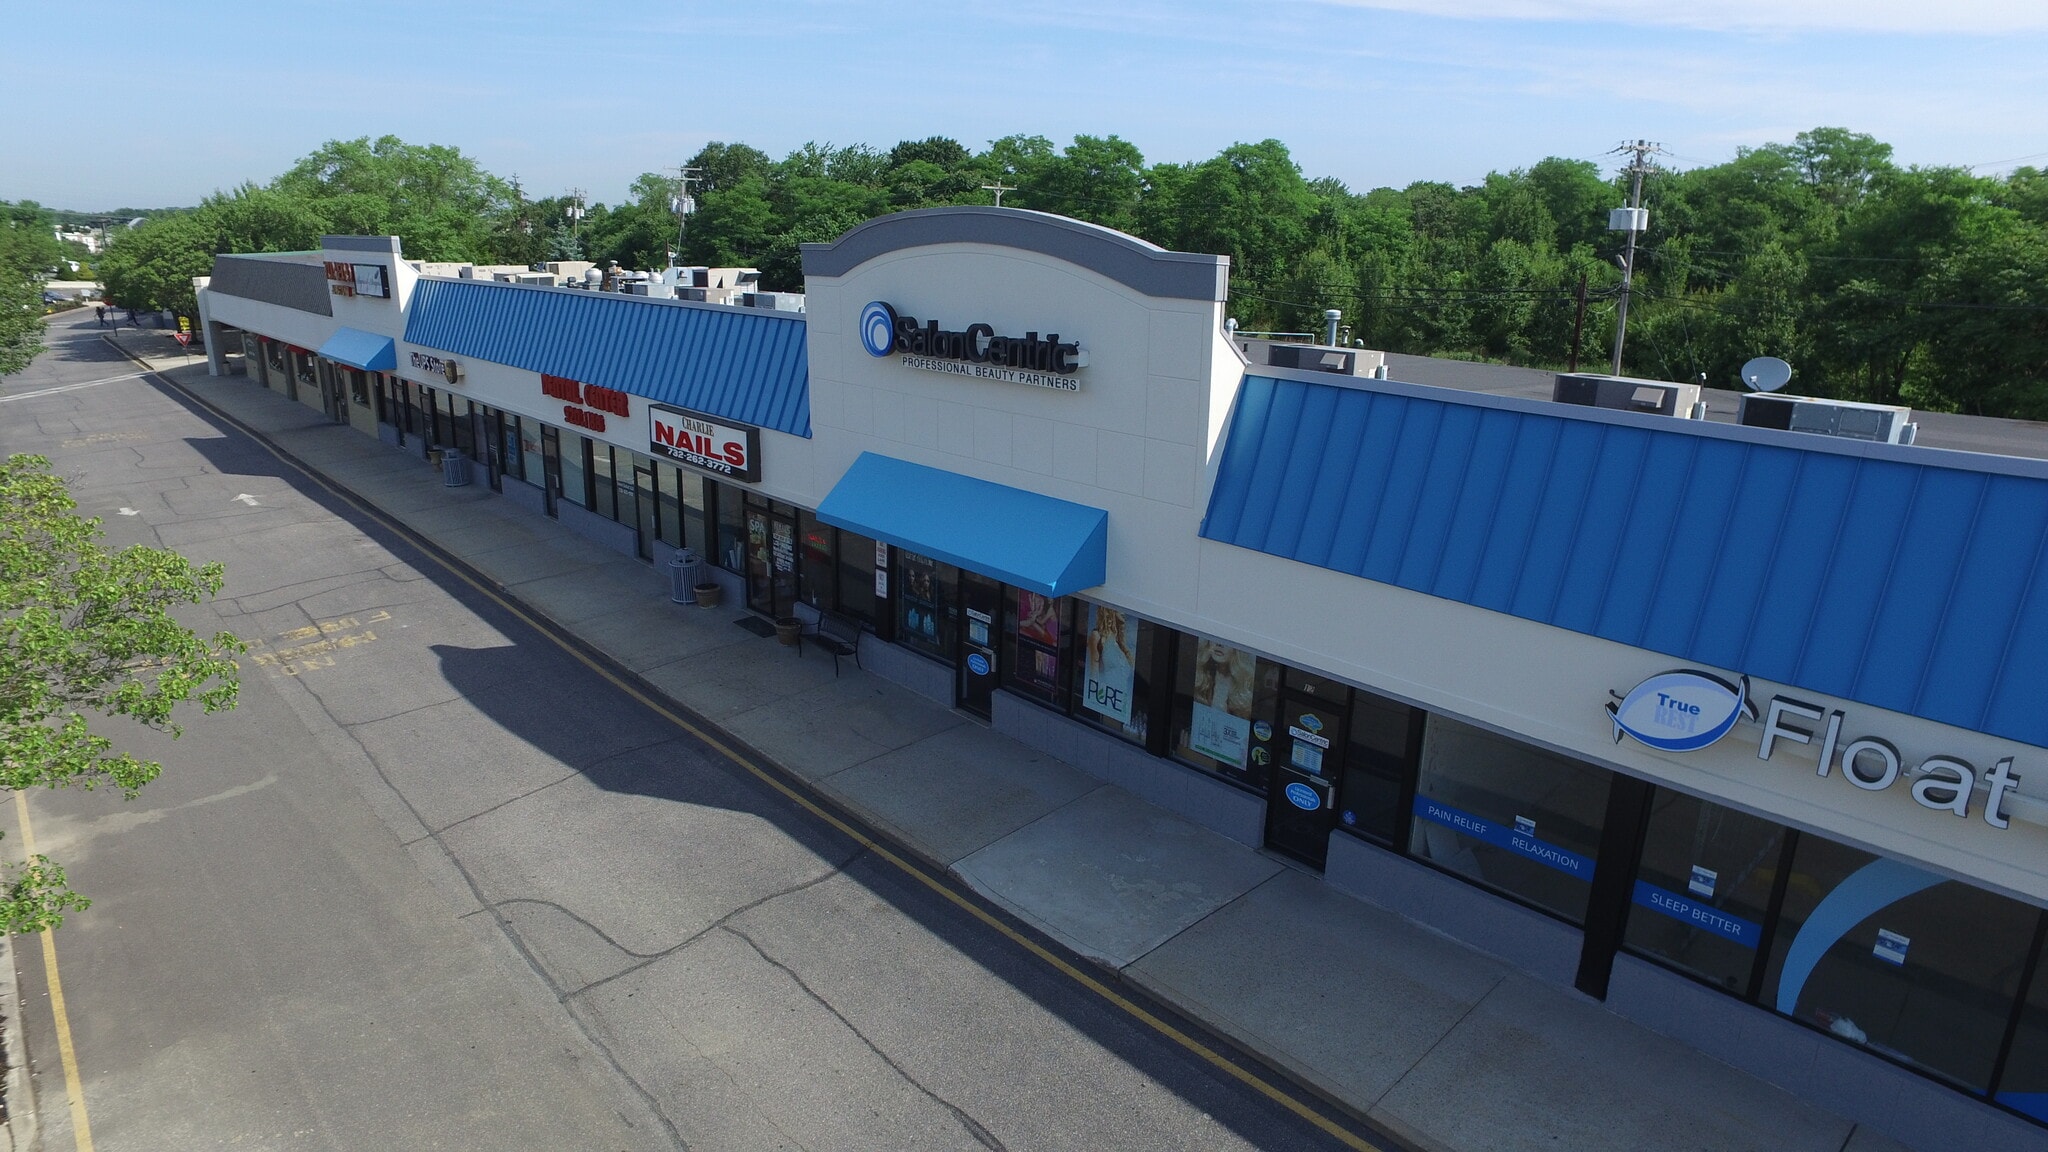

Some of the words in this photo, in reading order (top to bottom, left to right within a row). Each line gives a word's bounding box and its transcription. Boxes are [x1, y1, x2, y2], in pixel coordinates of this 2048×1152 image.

[894, 316, 1079, 375] SalonCentric
[902, 356, 972, 376] PROFESSIONAL
[975, 366, 1015, 382] BEAUTY
[1019, 372, 1077, 391] PARTNERS
[681, 416, 715, 437] CHARLIE
[655, 420, 745, 466] NAILS
[667, 447, 732, 474] 732-262-3772
[750, 519, 765, 536] SPA
[1088, 679, 1123, 712] PURE
[1657, 692, 1700, 717] True
[1654, 704, 1697, 733] REST
[1757, 694, 2021, 830] Float
[1293, 795, 1313, 807] ONLY
[1427, 805, 1451, 822] PAIN
[1453, 815, 1488, 835] RELIEF
[1511, 836, 1579, 871] RELAXATION
[1650, 892, 1689, 915] SLEEP
[1692, 908, 1742, 936] BETTER
